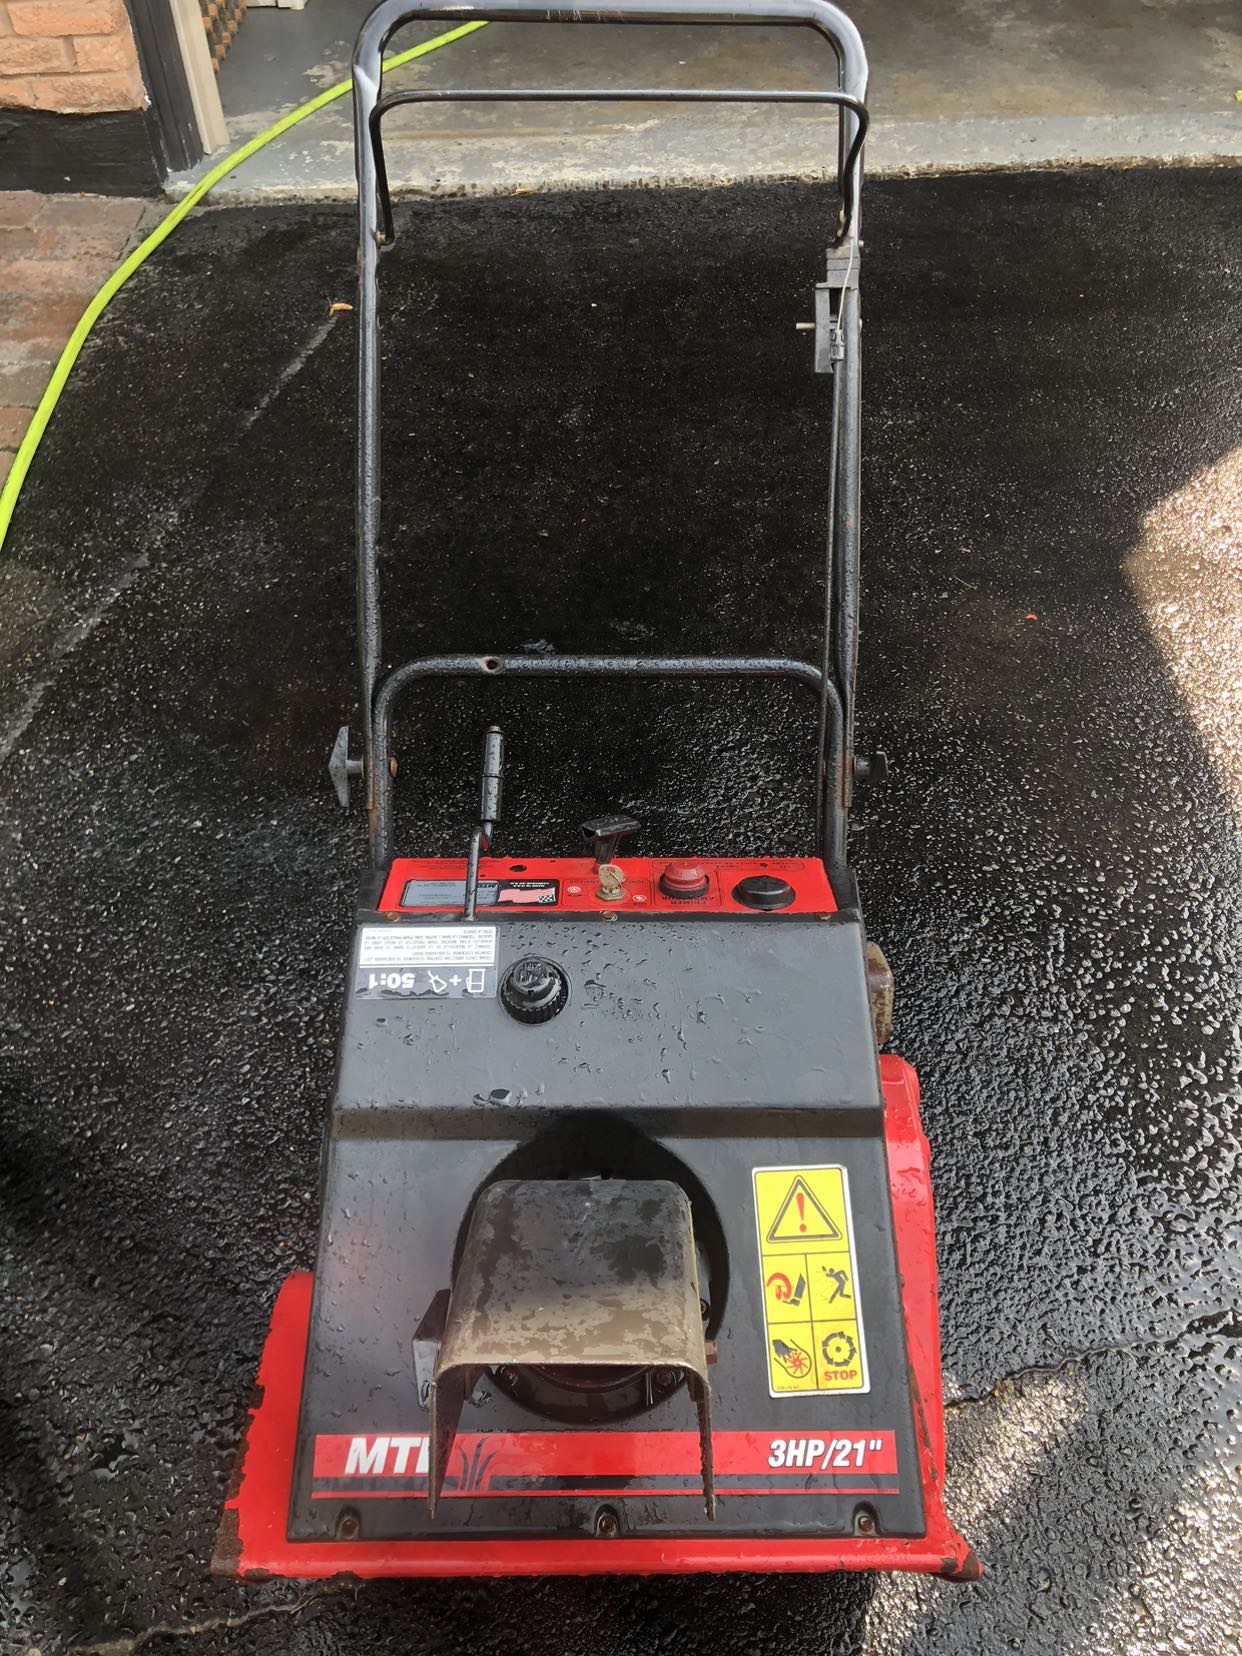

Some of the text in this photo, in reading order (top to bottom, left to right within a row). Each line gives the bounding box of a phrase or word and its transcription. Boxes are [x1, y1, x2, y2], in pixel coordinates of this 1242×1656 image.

[369, 972, 415, 989] 50:1
[824, 1369, 857, 1381] STOP
[767, 1439, 882, 1470] 3HP/21"
